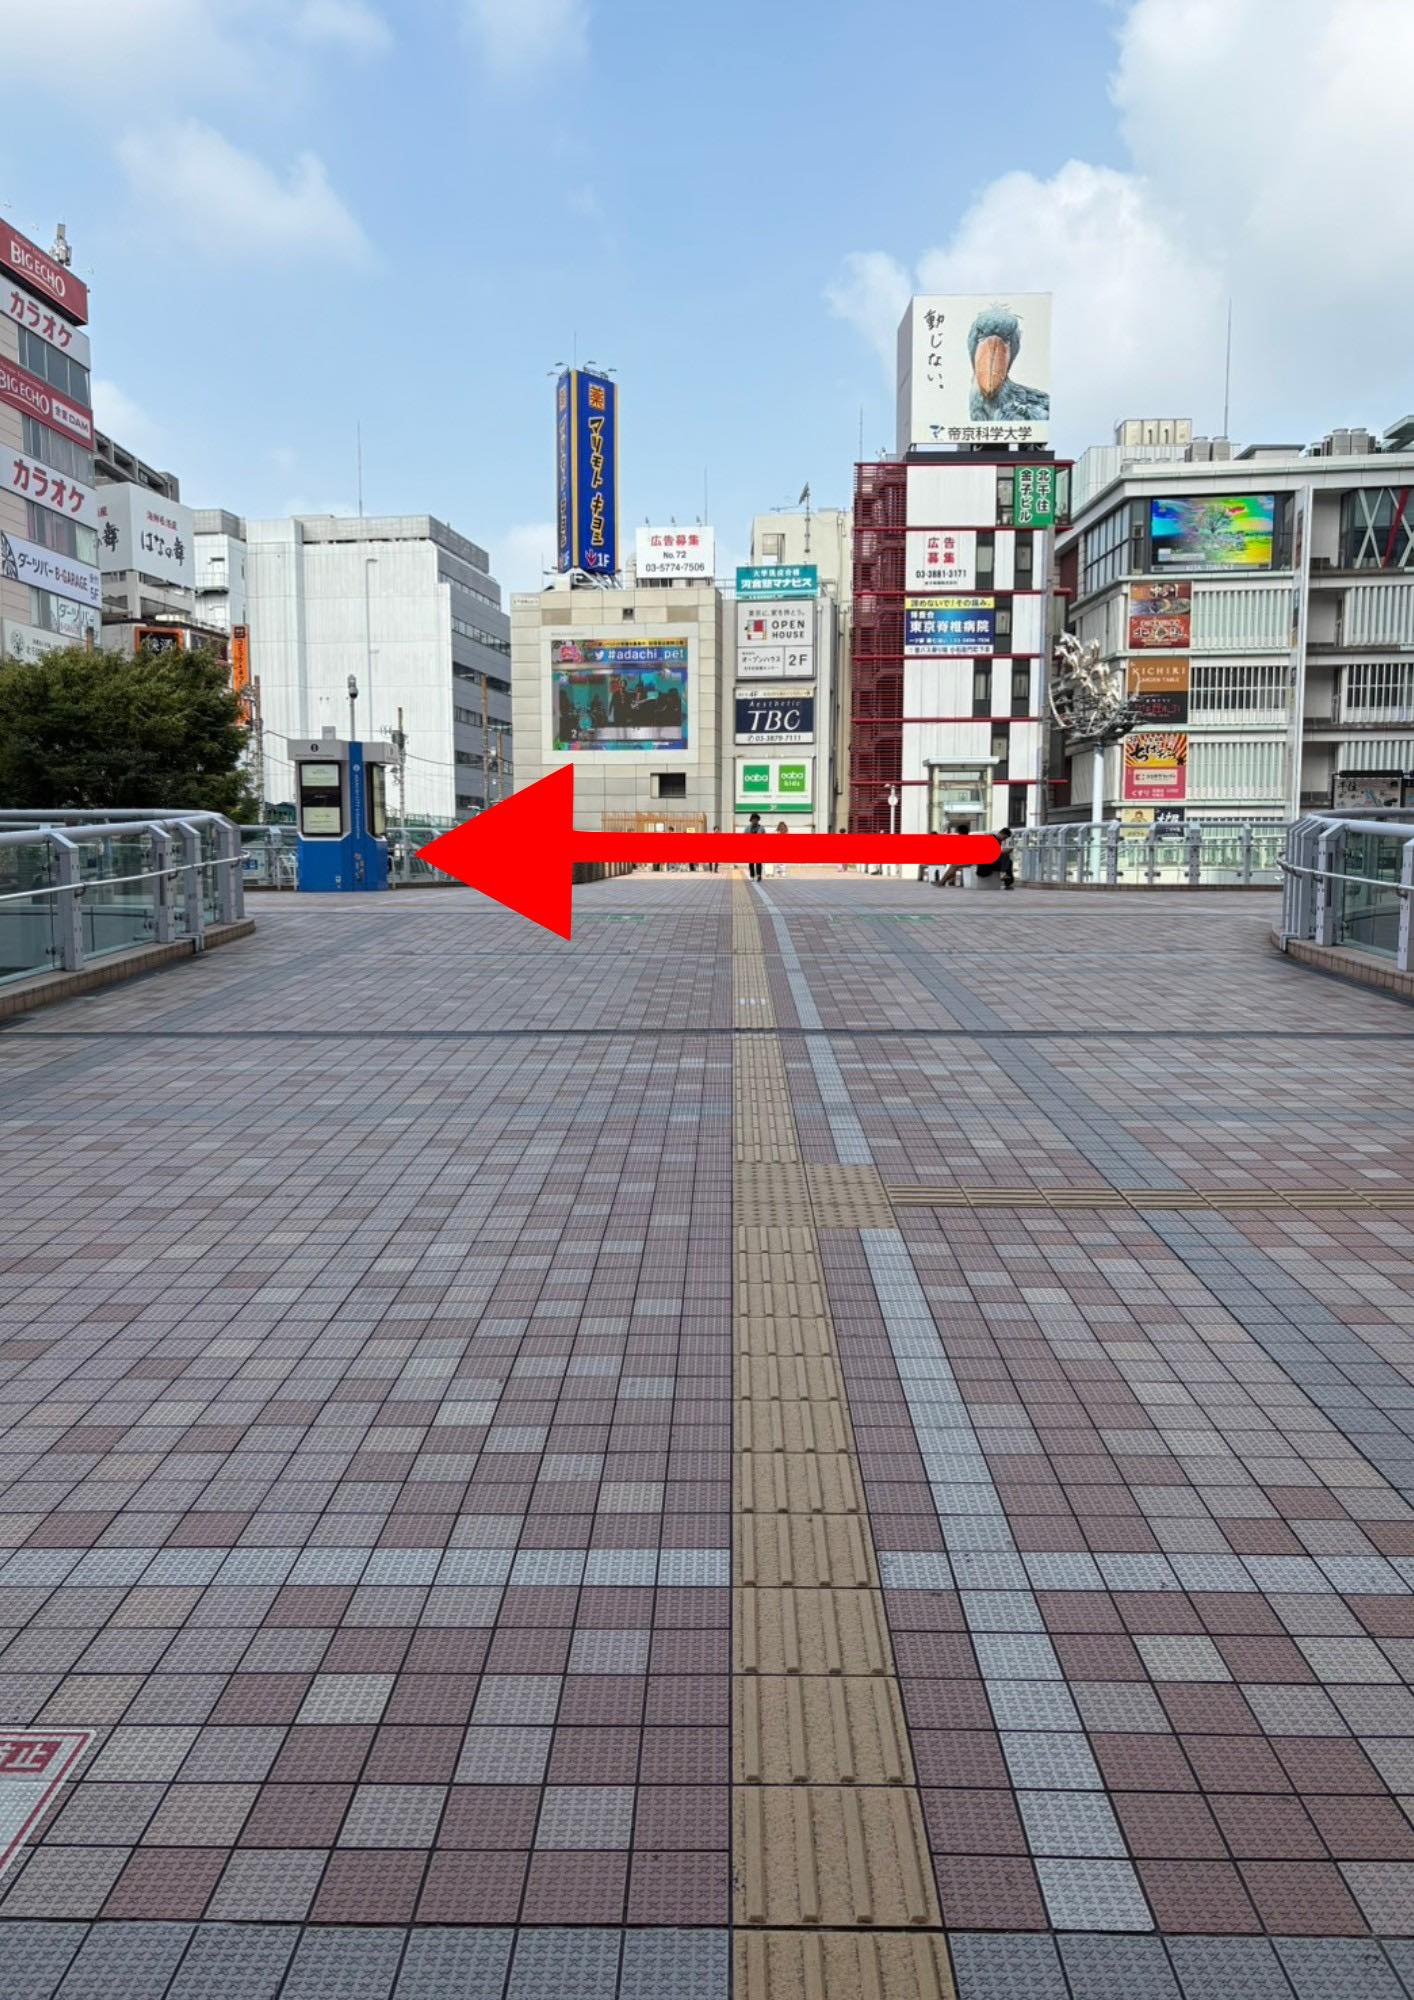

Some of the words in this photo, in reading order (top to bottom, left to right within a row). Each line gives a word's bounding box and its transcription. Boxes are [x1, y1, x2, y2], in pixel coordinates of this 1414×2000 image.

[11, 240, 33, 270] BIG
[34, 259, 65, 298] ECHO
[10, 290, 73, 347] カラオケ
[20, 384, 50, 415] ECHO
[589, 384, 605, 410] 薬
[948, 426, 1032, 441] 帝京科学大学
[13, 459, 84, 513] カラオケ
[1020, 468, 1033, 523] 金子ビル
[1036, 468, 1050, 513] 北千住
[141, 530, 185, 566] はなの舞
[651, 534, 699, 547] 広告募集
[928, 537, 956, 549] 広告
[18, 553, 54, 577] ダーツバー
[928, 552, 955, 564] 募集
[741, 578, 812, 589] 河合塾マナビス
[772, 620, 805, 629] OPEN
[772, 631, 805, 639] HOUSE
[789, 654, 808, 666] 2F
[747, 709, 801, 731] TBC
